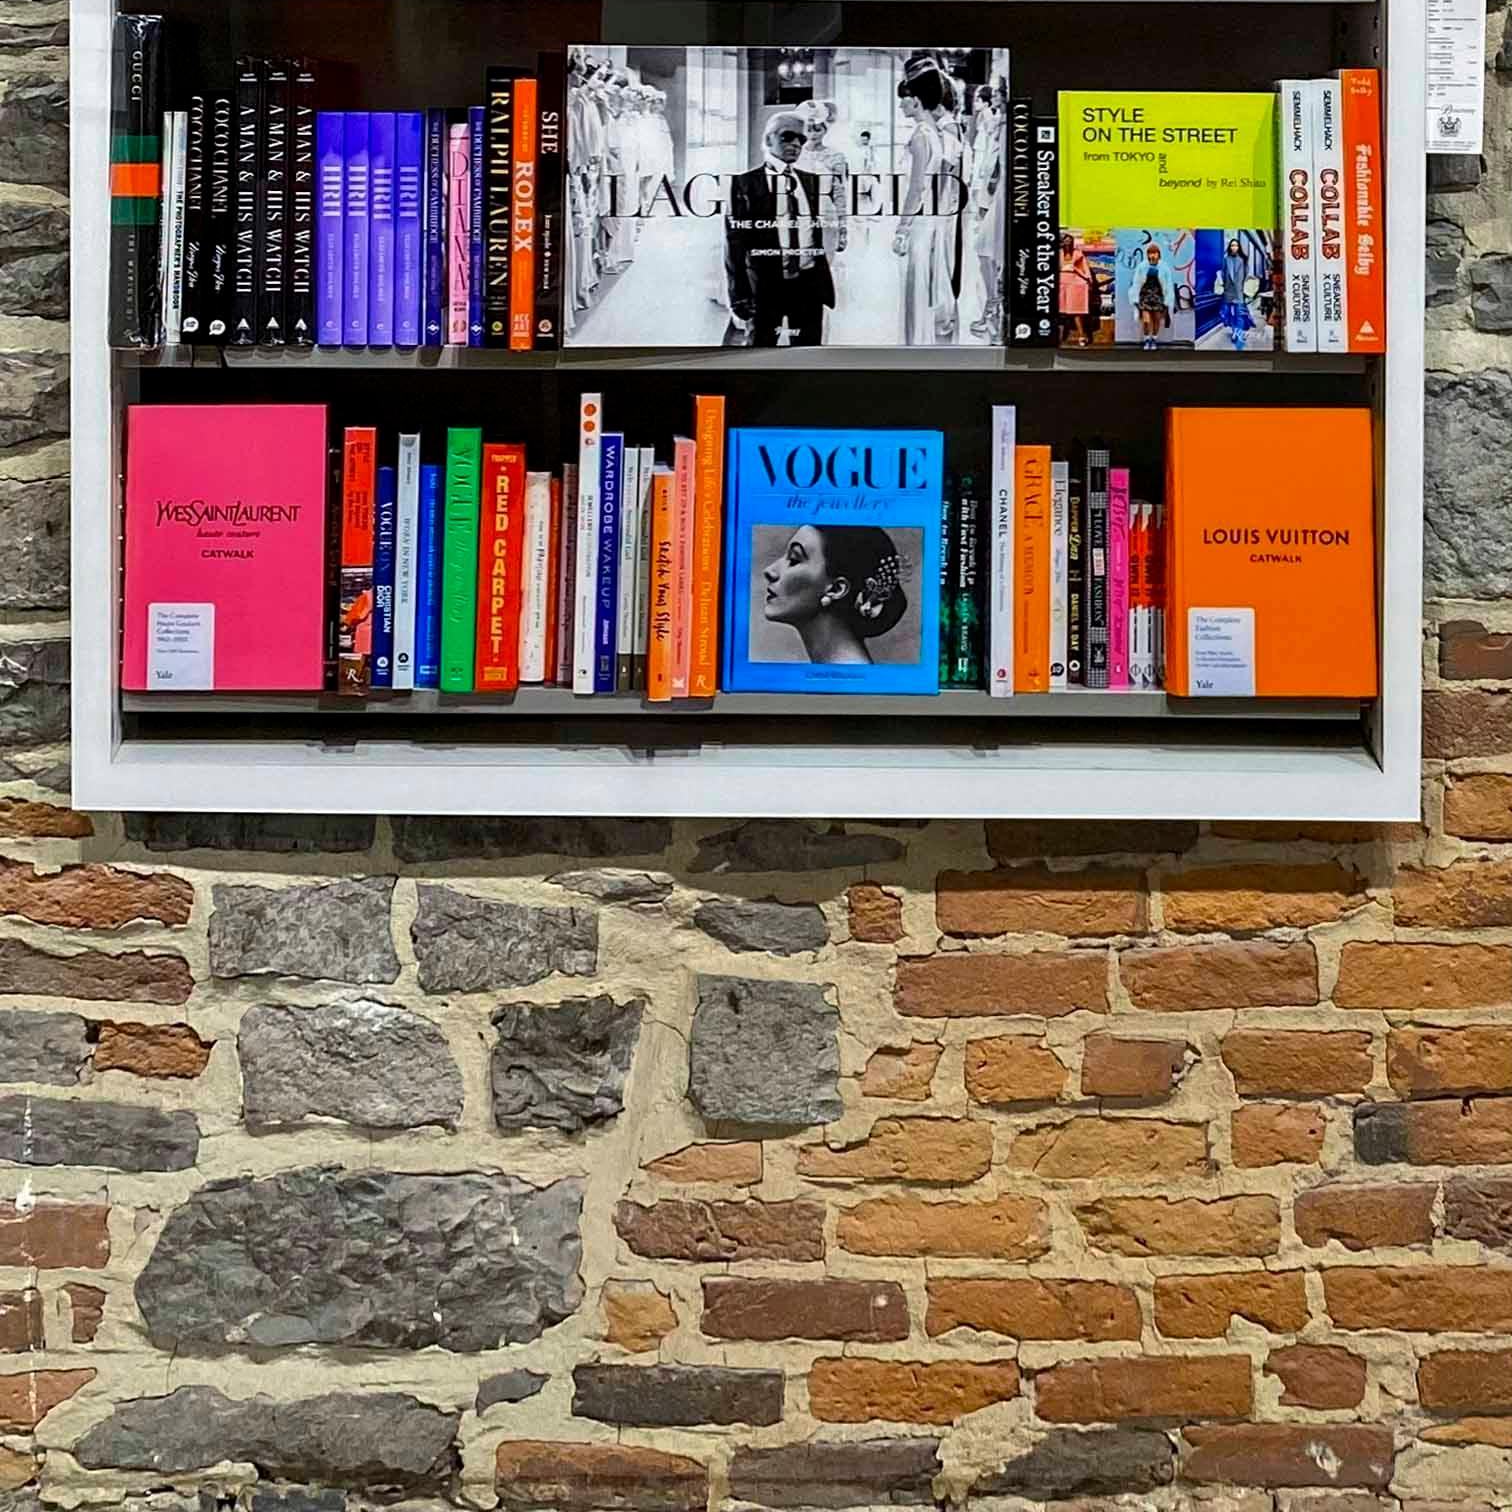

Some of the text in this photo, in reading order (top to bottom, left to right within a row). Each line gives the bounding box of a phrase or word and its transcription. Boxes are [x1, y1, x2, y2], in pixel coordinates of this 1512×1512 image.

[541, 111, 559, 154] SHE
[1082, 108, 1144, 124] STYLE
[1082, 128, 1238, 144] ON THE STREET
[1113, 152, 1155, 162] TOKYO
[1159, 177, 1201, 189] beyond
[513, 160, 534, 252] ROLEX
[1288, 168, 1309, 261] COLLAB
[1319, 168, 1340, 261] COLLAB
[1036, 150, 1055, 312] Sneaker of the Year
[758, 445, 928, 489] VOGUE
[601, 446, 616, 609] WARDROBE WAKEUP
[998, 488, 1008, 537] CHANEL
[201, 550, 254, 559] CATWALK
[1204, 529, 1350, 545] LOUIS VUITTON
[491, 476, 511, 655] RED CARPET
[1250, 555, 1302, 563] CATWALK
